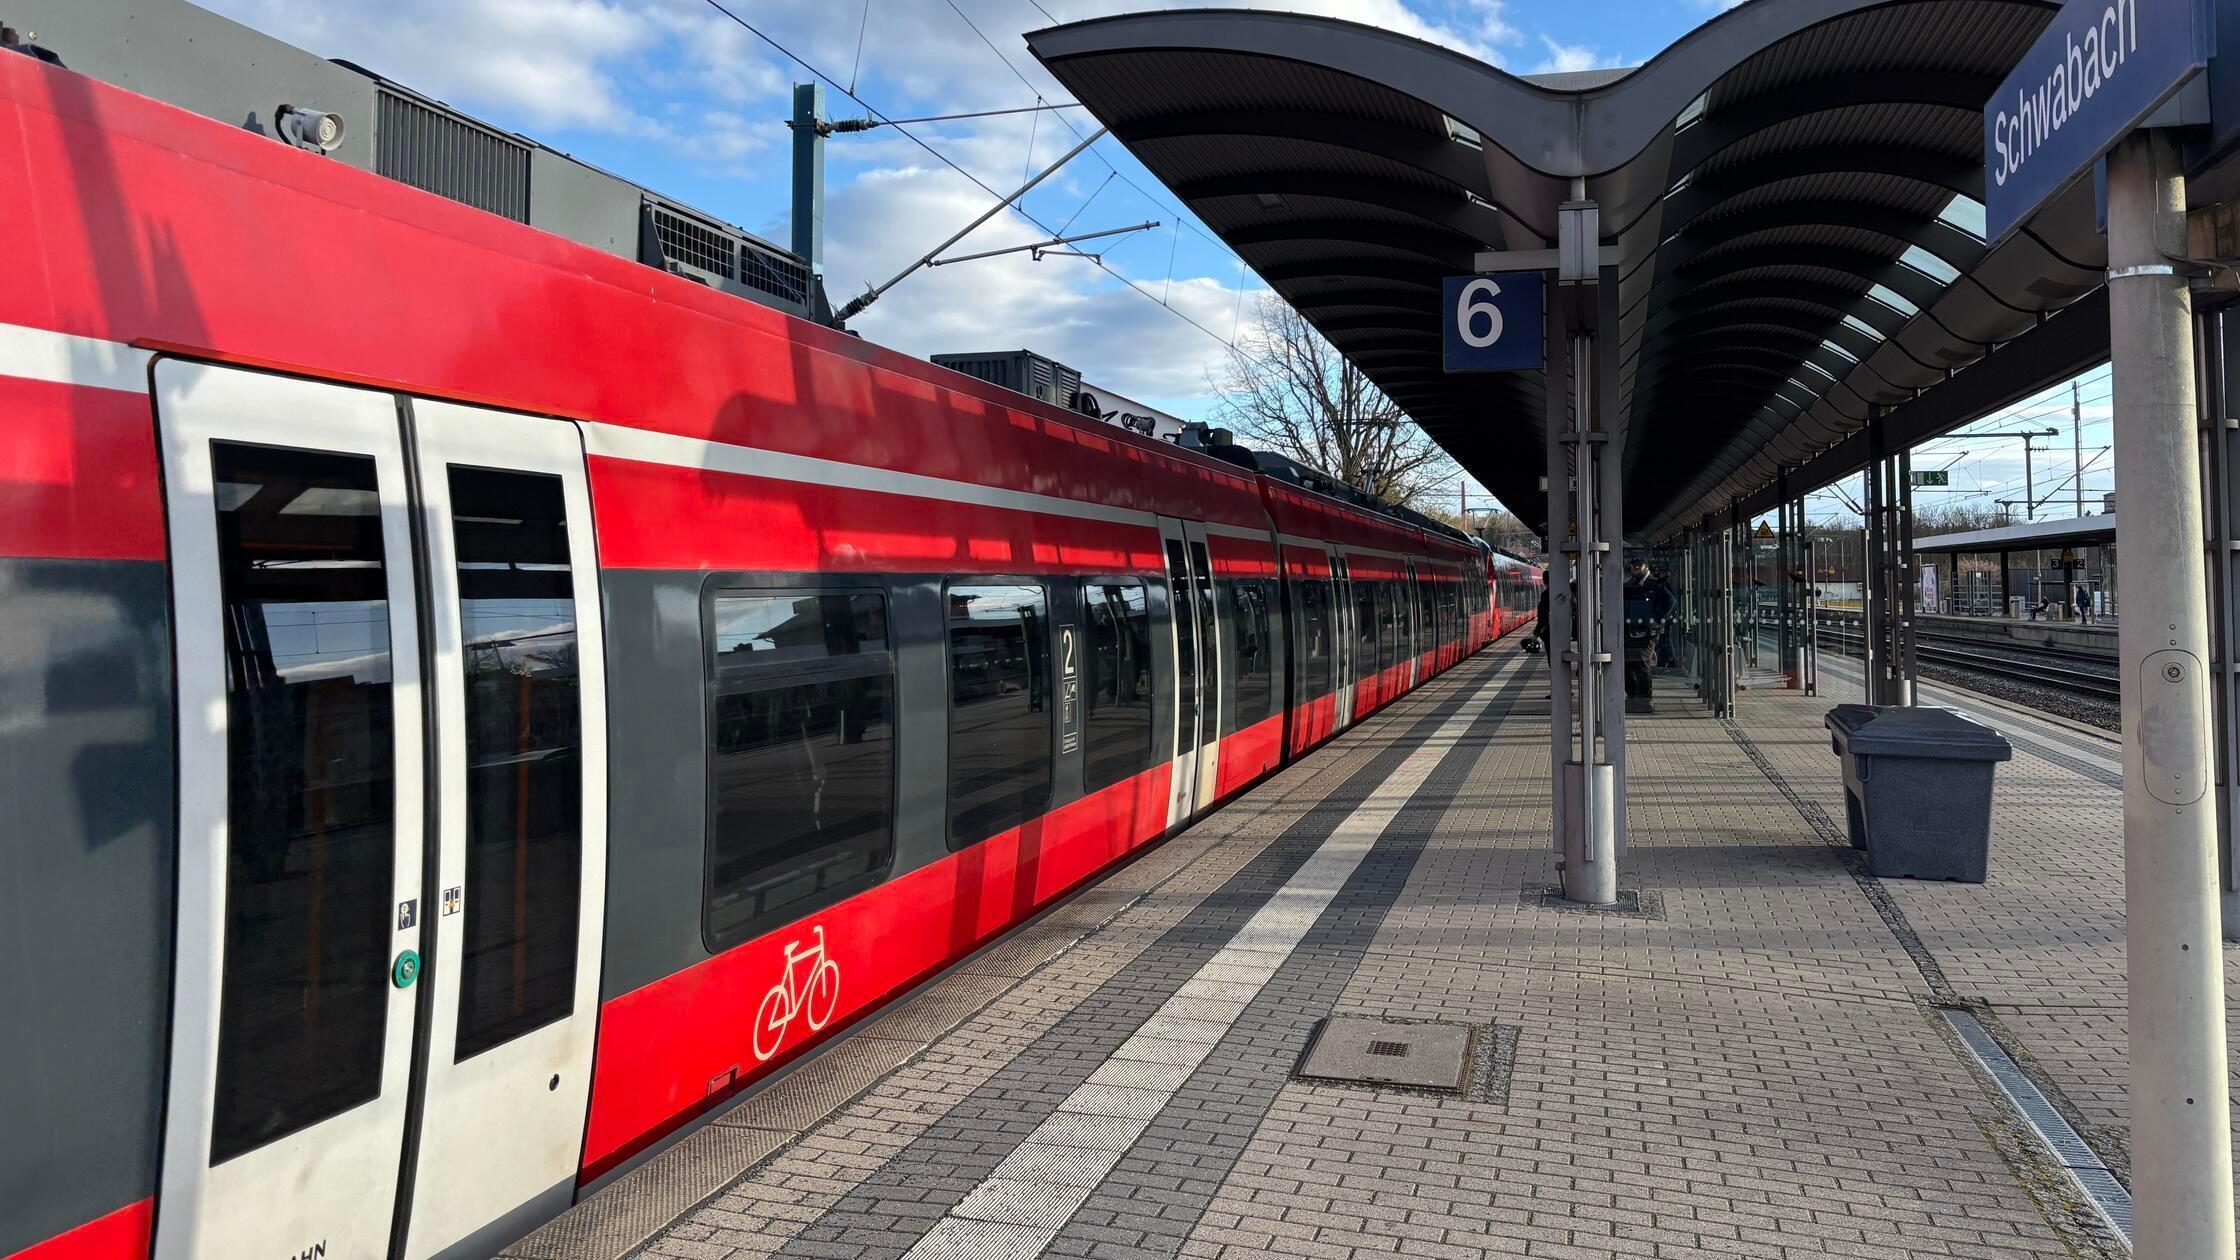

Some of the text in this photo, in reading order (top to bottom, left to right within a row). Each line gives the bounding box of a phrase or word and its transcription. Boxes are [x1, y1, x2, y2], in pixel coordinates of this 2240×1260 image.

[1457, 278, 1504, 348] 6
[2052, 559, 2059, 568] 3
[2076, 559, 2084, 568] 2
[1063, 629, 1075, 675] 2
[291, 1239, 327, 1260] HN
